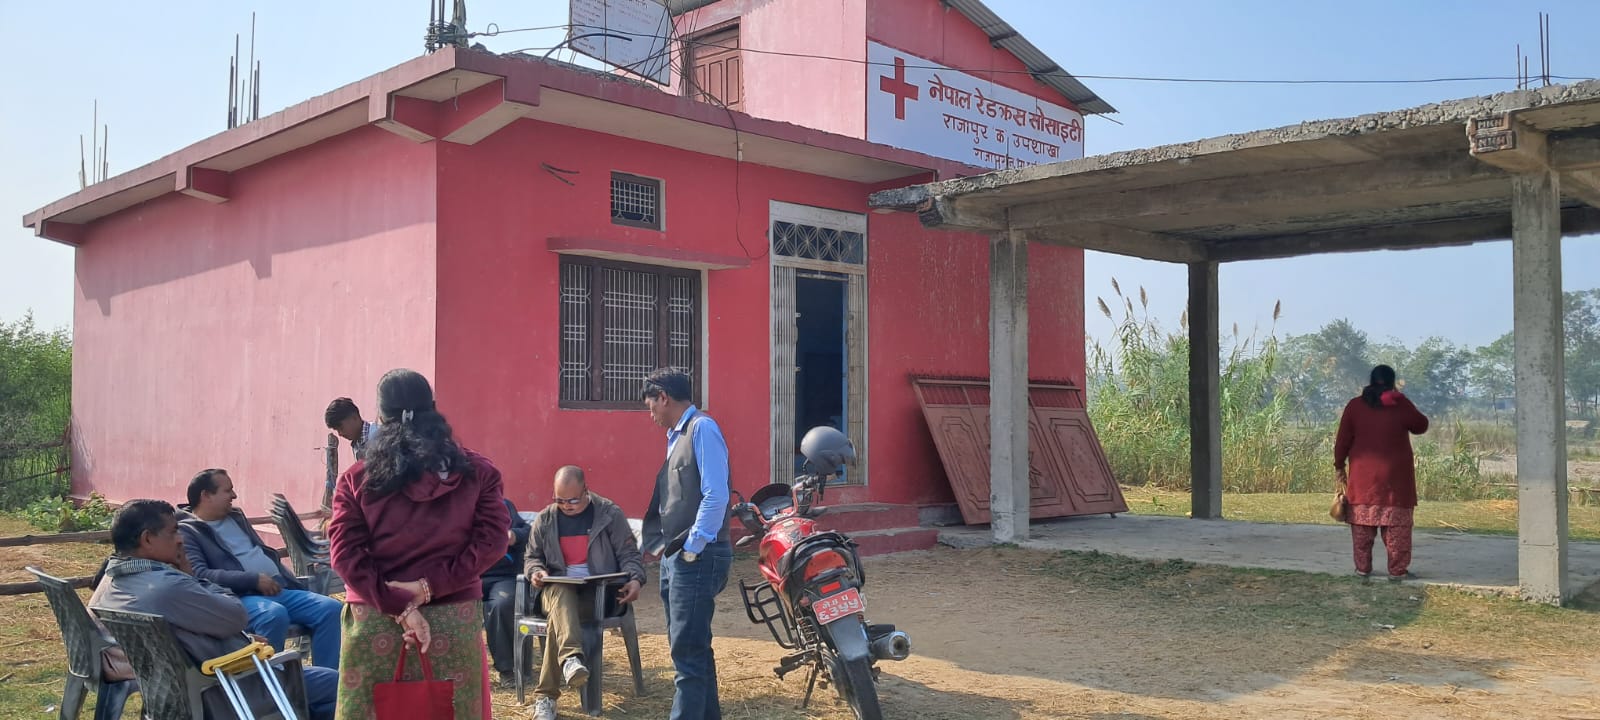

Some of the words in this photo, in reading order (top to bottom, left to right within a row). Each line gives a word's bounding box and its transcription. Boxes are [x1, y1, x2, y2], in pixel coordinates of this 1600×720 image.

[928, 74, 972, 110] नेपाल
[974, 88, 1027, 127] रेडक्रस
[1029, 106, 1082, 143] सोसाइटी
[943, 113, 988, 144] राजापुर
[1013, 134, 1060, 158] उपशाखा
